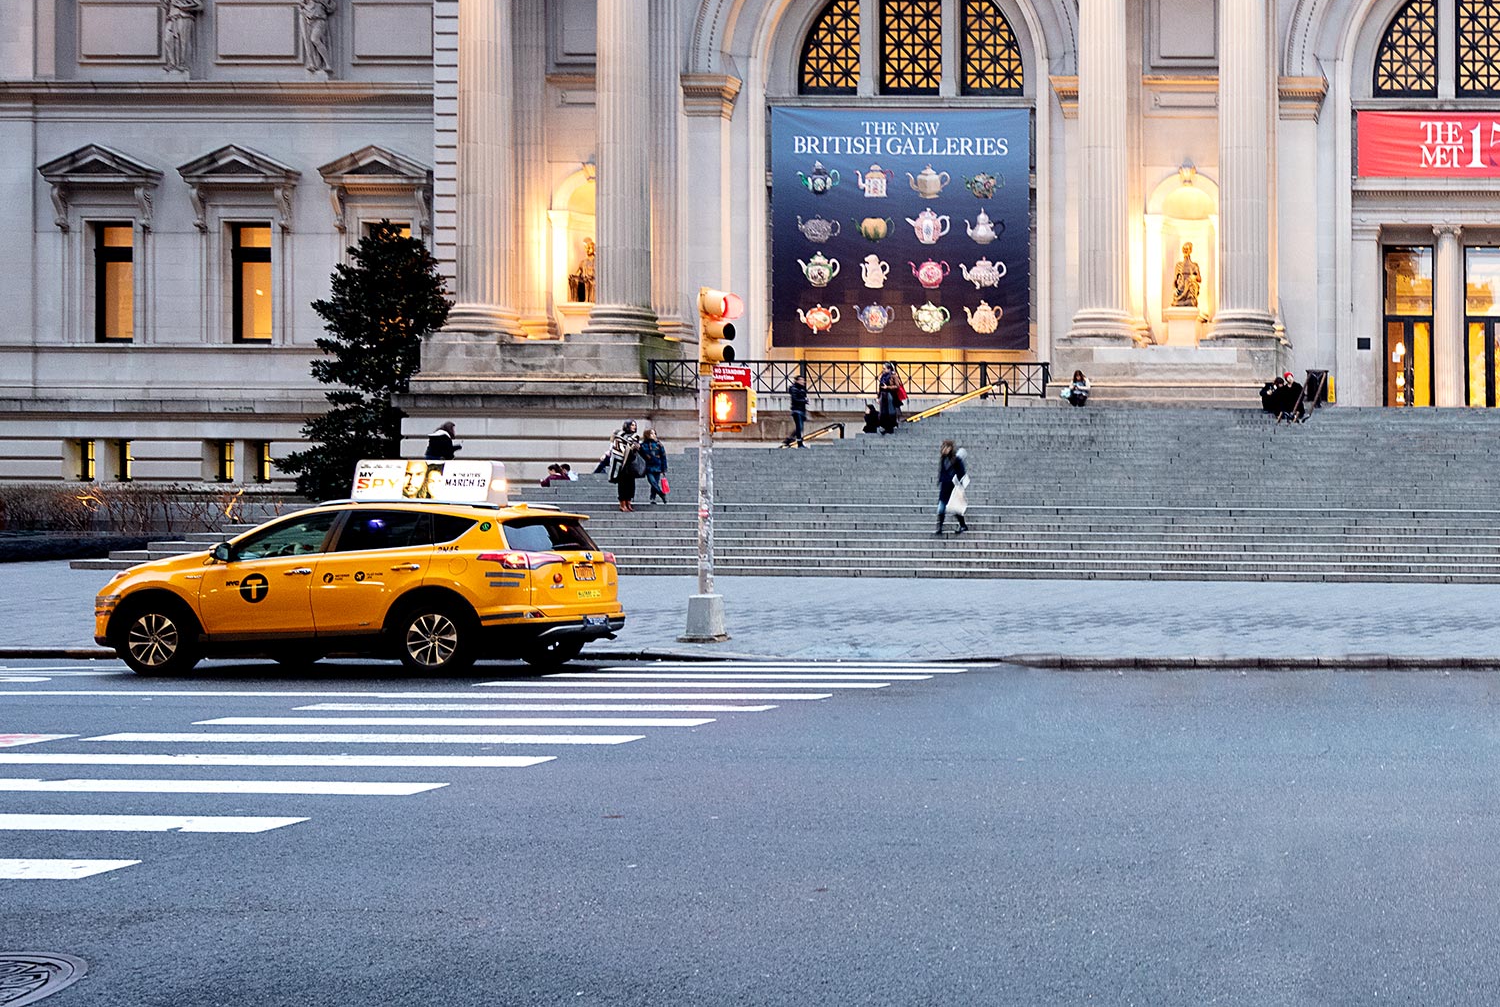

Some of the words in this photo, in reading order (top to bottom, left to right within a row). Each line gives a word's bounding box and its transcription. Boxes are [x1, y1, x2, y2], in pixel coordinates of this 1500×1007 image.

[861, 122, 898, 135] THE
[900, 122, 940, 136] NEW
[1420, 122, 1464, 144] THE
[793, 136, 882, 155] BRITISH
[886, 137, 1009, 156] GALLERIES
[1419, 145, 1465, 168] MET
[357, 478, 399, 489] SPY
[445, 479, 475, 487] MARCH
[477, 479, 486, 487] 13
